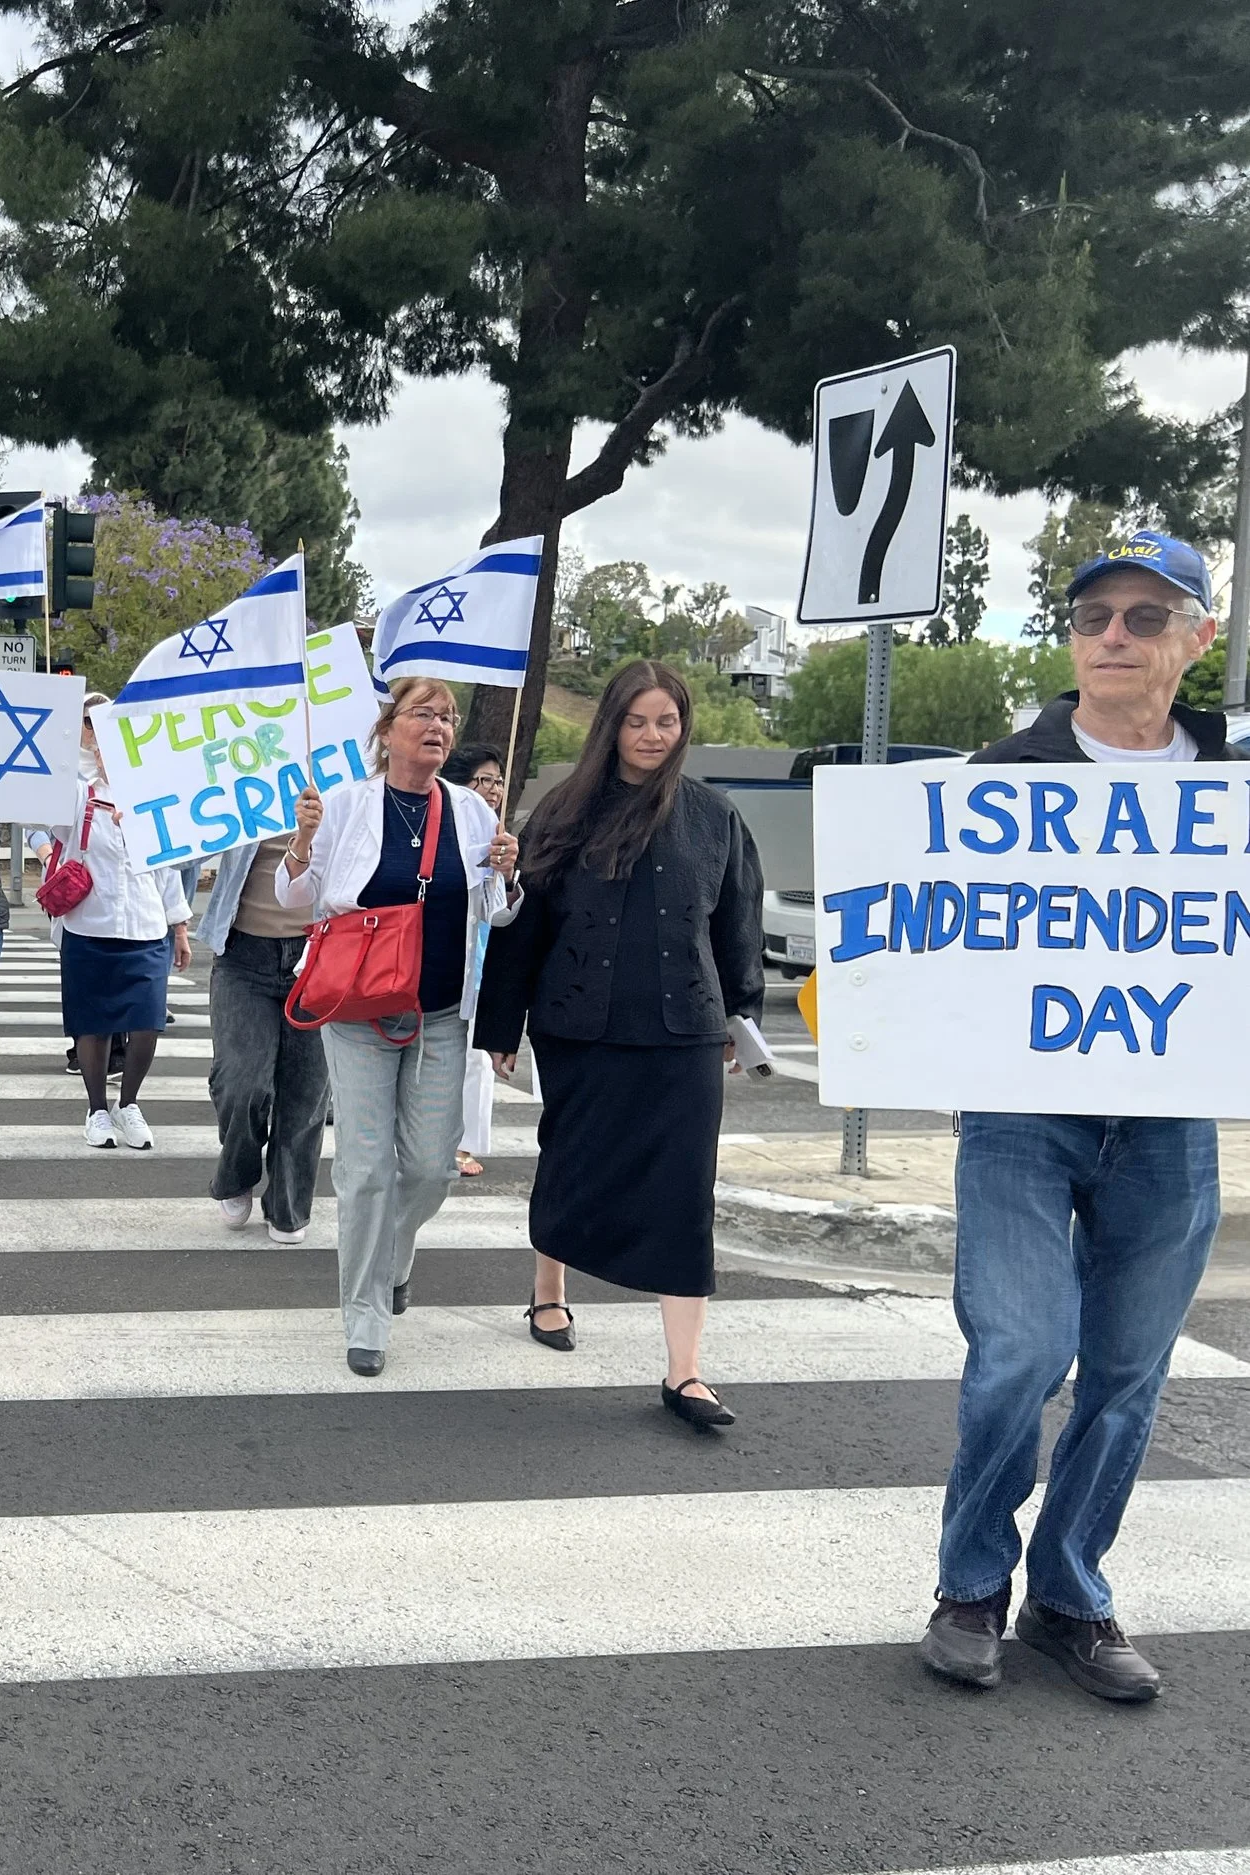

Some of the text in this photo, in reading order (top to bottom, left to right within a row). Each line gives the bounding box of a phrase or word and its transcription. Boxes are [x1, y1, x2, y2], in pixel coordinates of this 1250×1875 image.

[2, 656, 26, 665] TURN
[4, 642, 24, 653] NO
[201, 723, 290, 785] FOR
[921, 780, 1250, 855] ISRAE
[1029, 982, 1194, 1056] DAY
